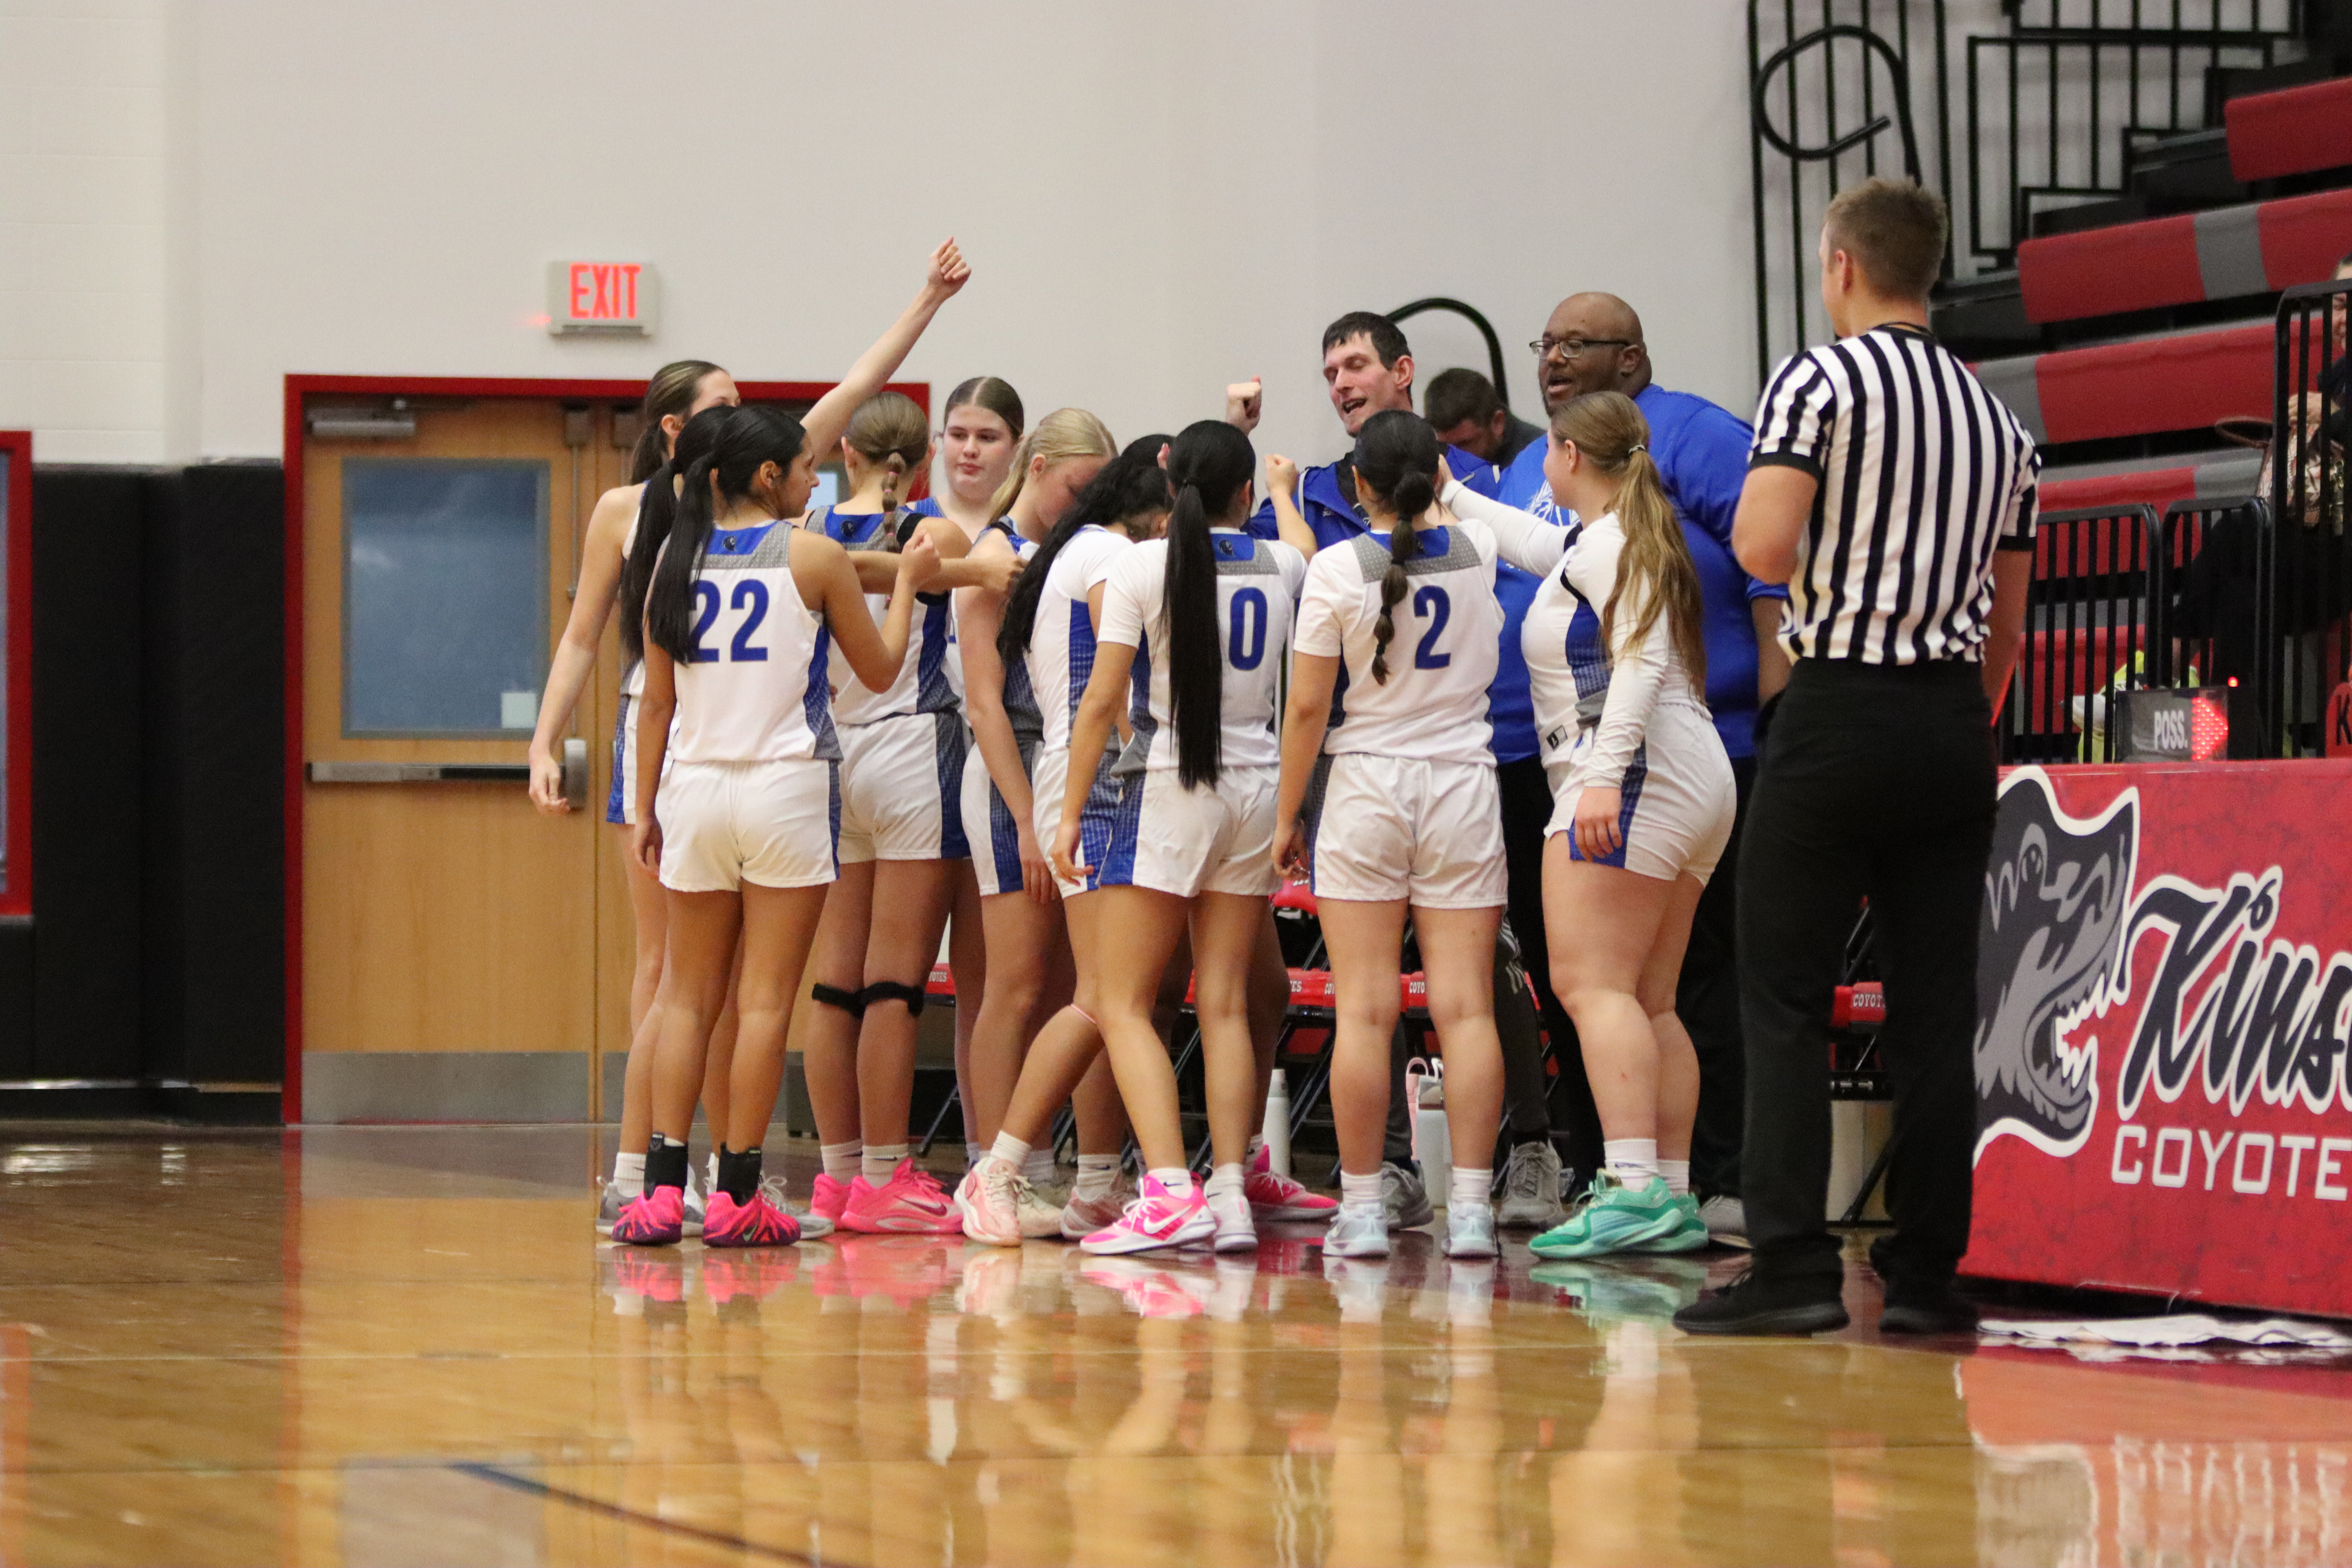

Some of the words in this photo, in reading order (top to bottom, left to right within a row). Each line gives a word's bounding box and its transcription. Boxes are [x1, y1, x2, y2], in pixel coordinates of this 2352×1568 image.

[570, 263, 641, 319] EXIT
[689, 579, 769, 662] 22
[1414, 586, 1451, 669] 2
[2154, 710, 2188, 750] POSS.
[1409, 981, 1425, 994] COYO
[1853, 993, 1886, 1008] COYOT
[2116, 878, 2352, 1110] Kins
[2112, 1125, 2352, 1201] COYOTE
